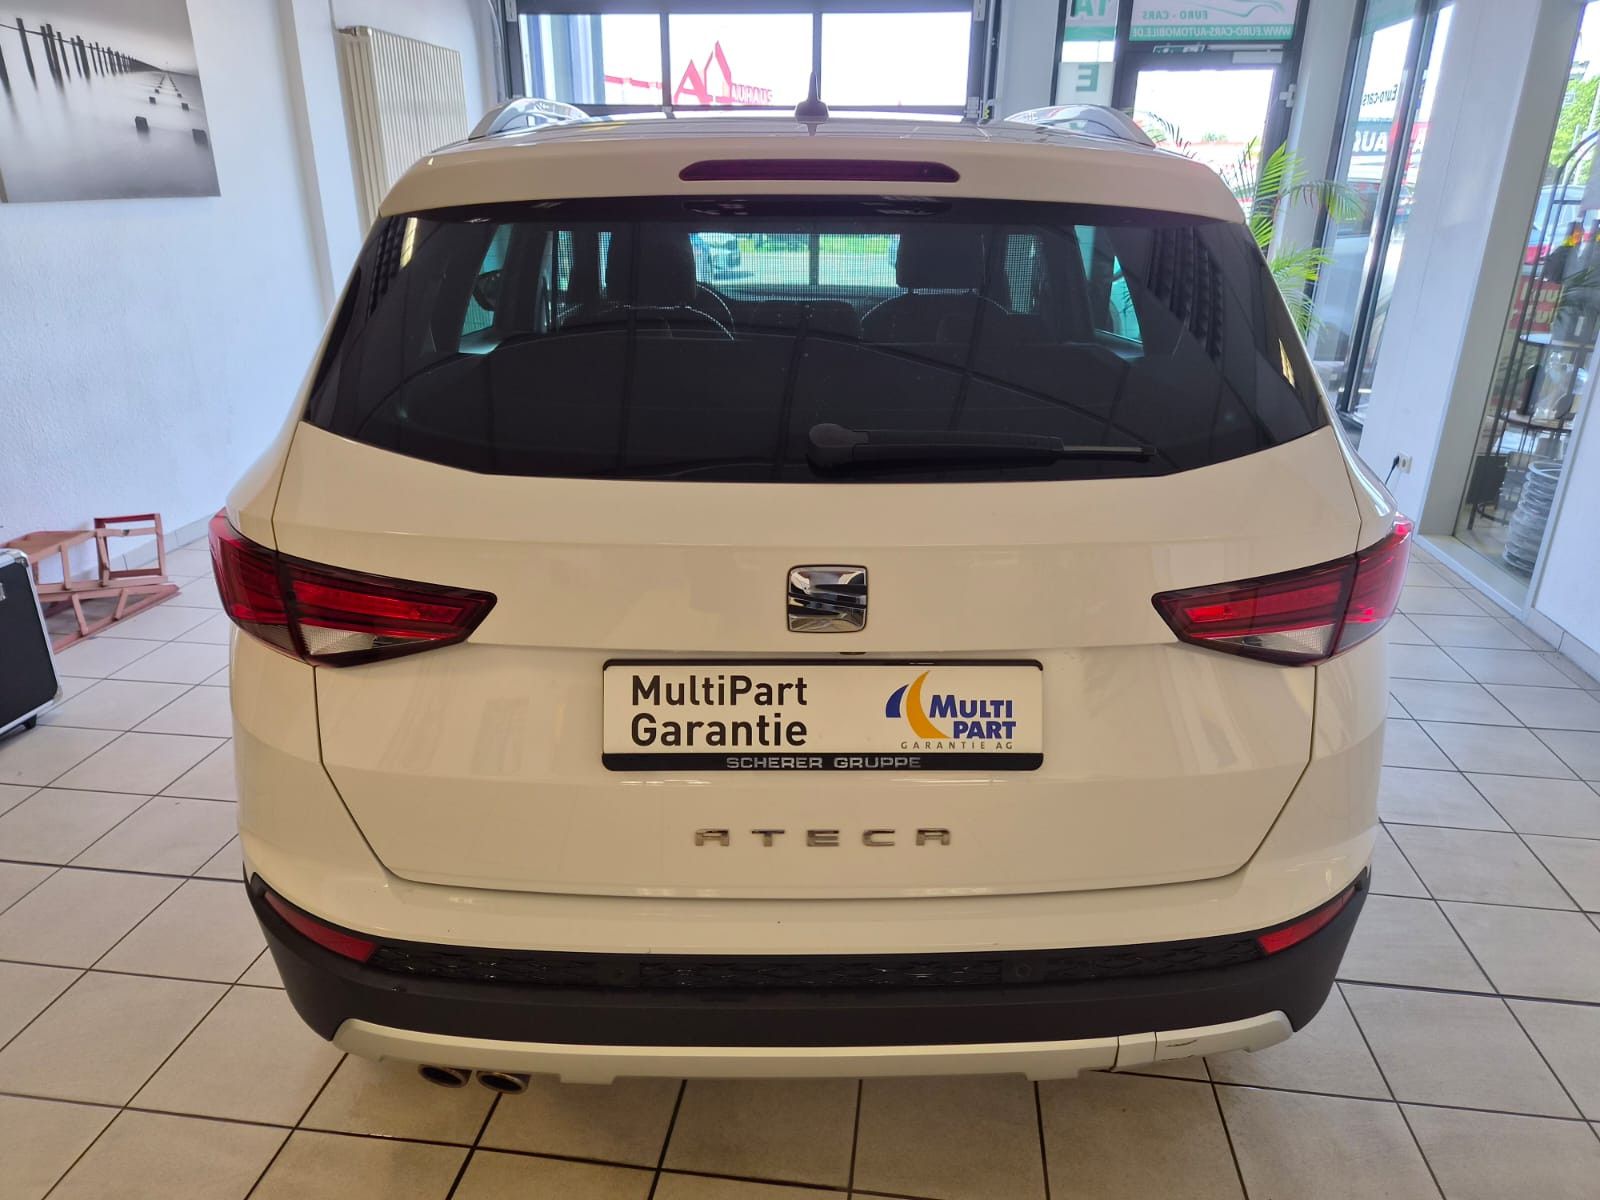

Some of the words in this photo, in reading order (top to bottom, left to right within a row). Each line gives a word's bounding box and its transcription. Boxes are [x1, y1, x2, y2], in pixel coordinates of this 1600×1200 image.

[631, 675, 808, 706] MultiPart
[929, 694, 1014, 718] MULTI
[631, 712, 808, 747] Garantie
[953, 720, 1017, 739] PART
[900, 741, 986, 750] GARANTIE
[995, 741, 1014, 750] AG
[726, 756, 824, 769] SCHERER
[833, 756, 922, 769] GRUPPE
[694, 828, 951, 848] ATECA
